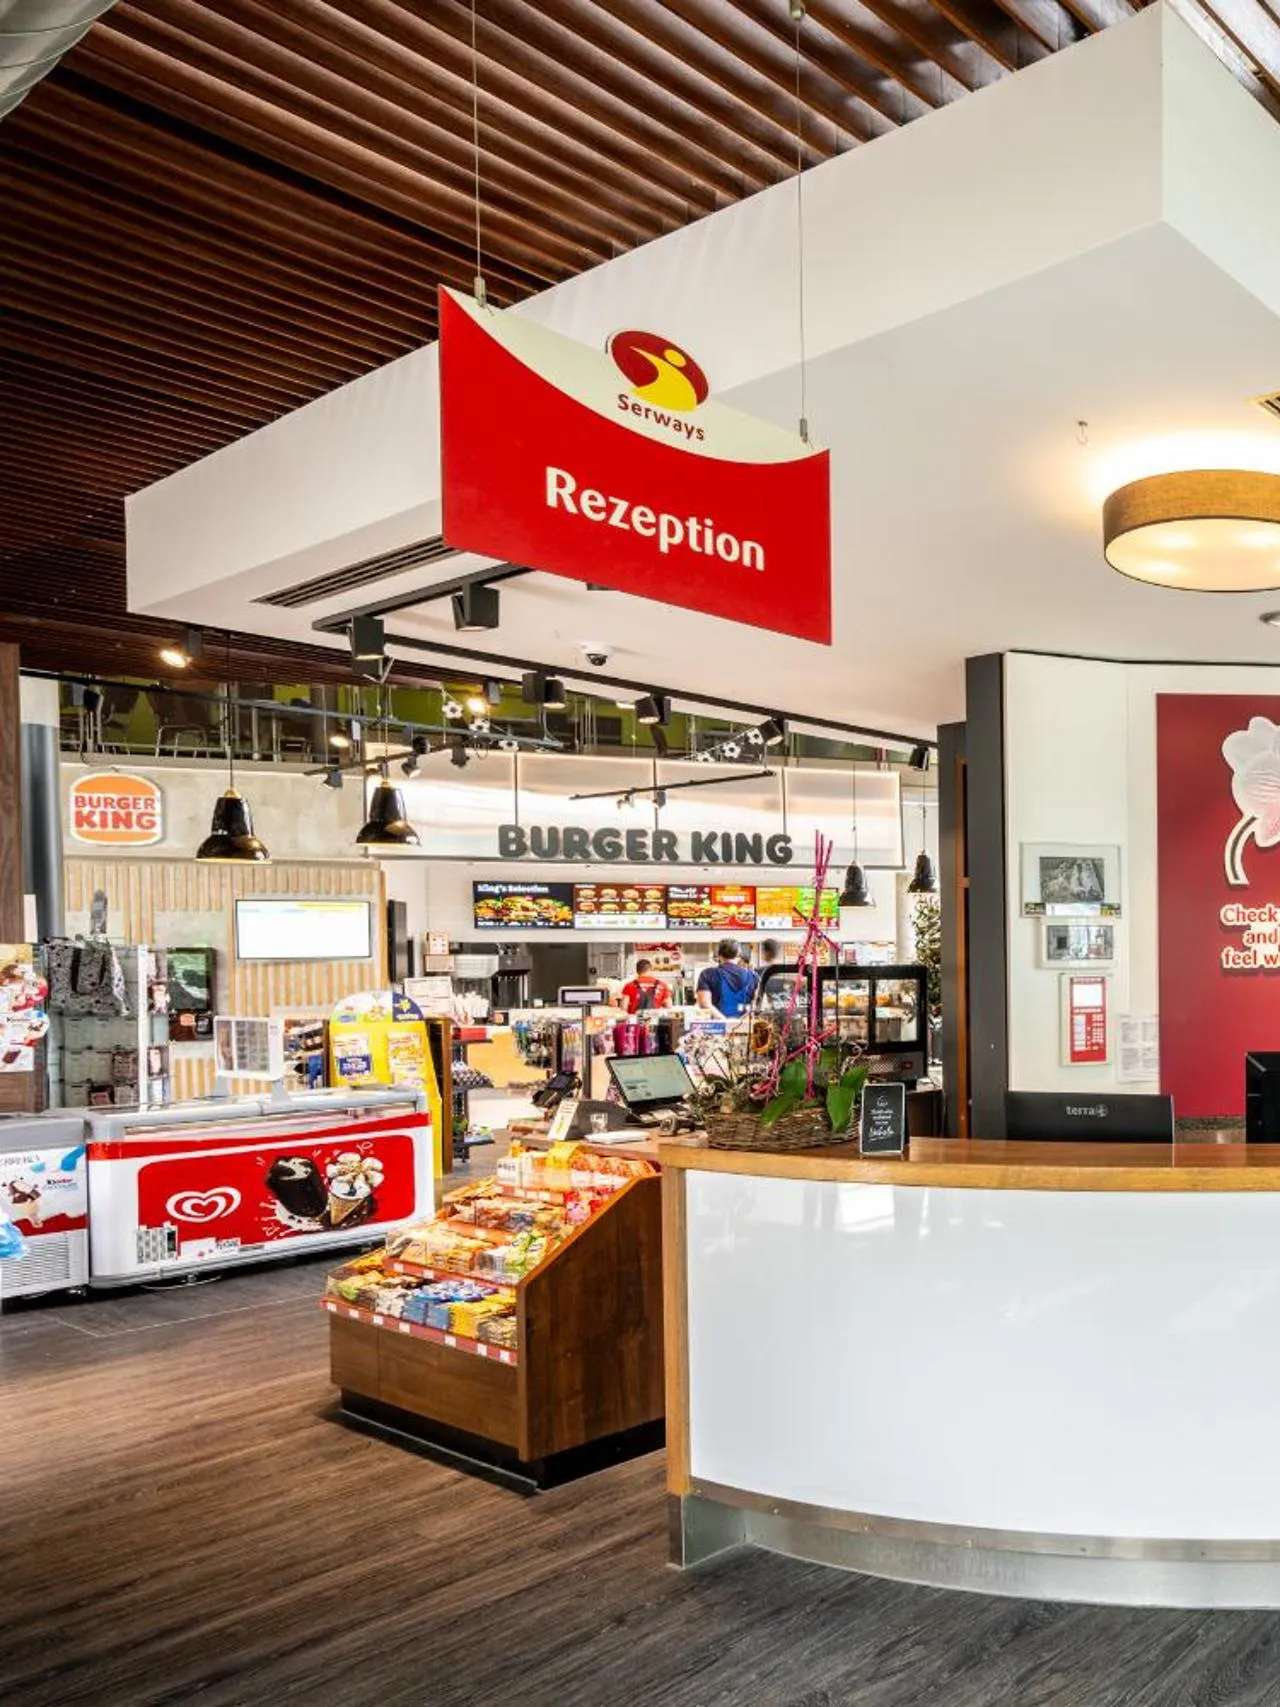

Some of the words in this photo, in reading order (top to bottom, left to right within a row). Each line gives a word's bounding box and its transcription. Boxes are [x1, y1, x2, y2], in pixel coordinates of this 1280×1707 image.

[617, 393, 706, 442] Serways
[545, 466, 765, 571] Rezeption
[74, 795, 156, 810] BURGER
[75, 810, 157, 830] KING
[498, 824, 679, 863] BURGER
[691, 830, 793, 864] KING
[1222, 905, 1278, 923] Check
[1244, 928, 1278, 944] and
[1223, 949, 1258, 966] feel
[1065, 1105, 1096, 1116] terra
